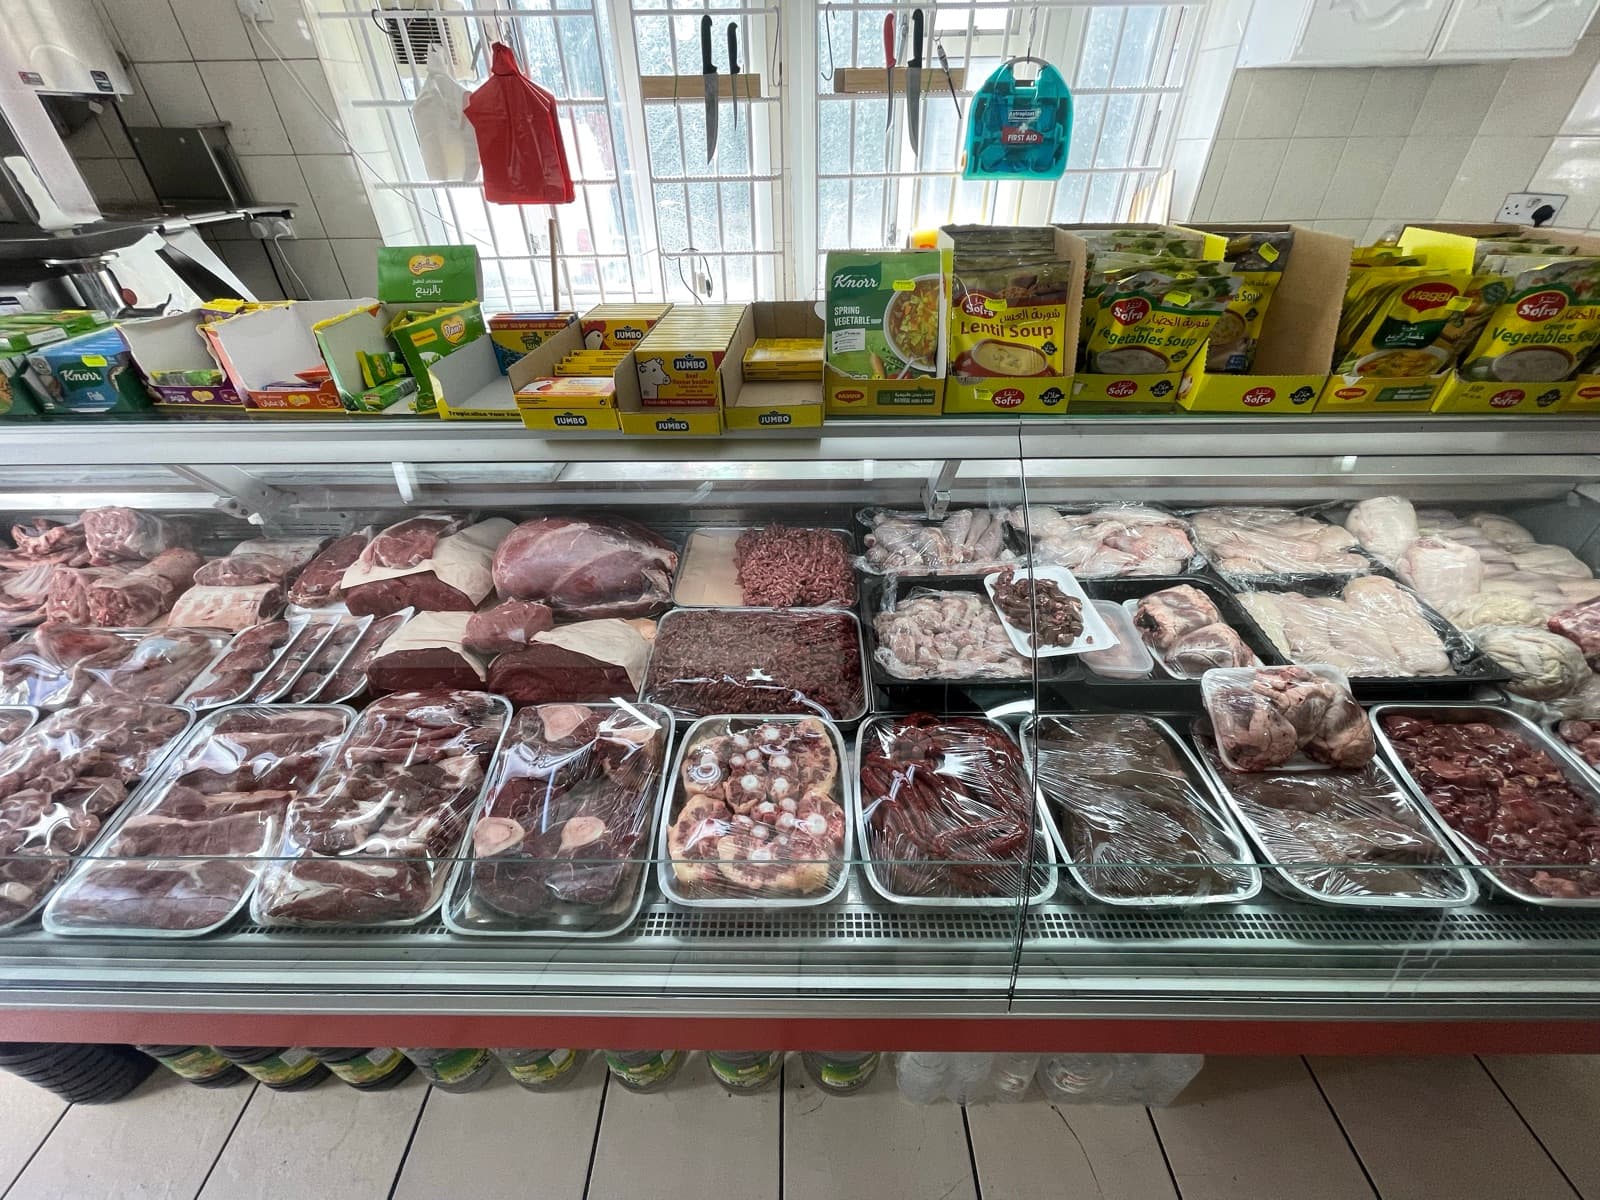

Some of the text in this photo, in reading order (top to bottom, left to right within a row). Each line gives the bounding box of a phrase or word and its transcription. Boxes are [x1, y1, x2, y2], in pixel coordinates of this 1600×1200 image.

[1007, 134, 1038, 142] FIRST AID
[833, 273, 879, 288] Knorr
[834, 306, 860, 315] SPRING
[1518, 303, 1559, 316] Sofra
[1113, 307, 1143, 322] Sofra
[833, 316, 872, 326] VEGETABLE
[960, 320, 1054, 339] Lentil Soup
[616, 330, 642, 339] JUMBO
[1492, 327, 1575, 346] Vegetables
[1164, 335, 1197, 348] Soup
[676, 360, 706, 369] JUMBO
[59, 369, 102, 381] Knorr
[1107, 387, 1134, 395] Sofra
[994, 396, 1021, 405] Sofra
[1244, 395, 1271, 404] Sofra
[1491, 397, 1519, 405] Sofra
[557, 417, 585, 425] JUMBO
[760, 415, 790, 424] JUMBO
[658, 422, 687, 430] JUMBO
